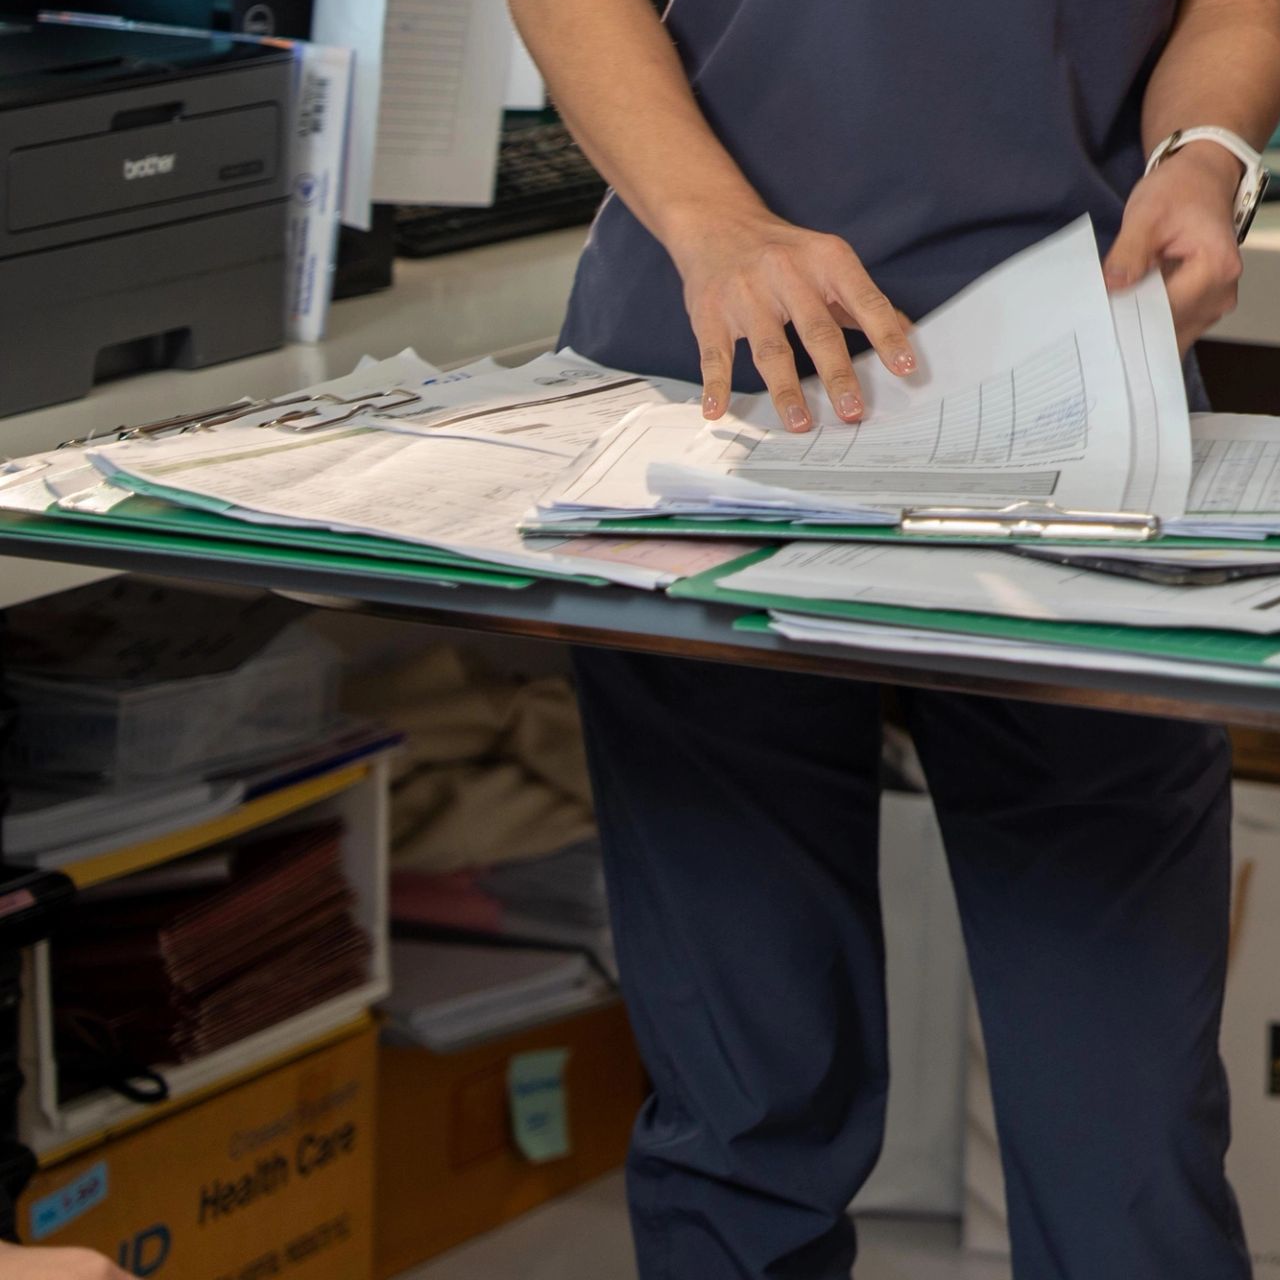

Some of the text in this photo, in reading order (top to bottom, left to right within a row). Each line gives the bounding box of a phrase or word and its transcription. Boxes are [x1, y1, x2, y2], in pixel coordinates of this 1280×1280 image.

[123, 152, 177, 180] brother
[198, 1152, 290, 1226] Health
[296, 1122, 355, 1178] Care
